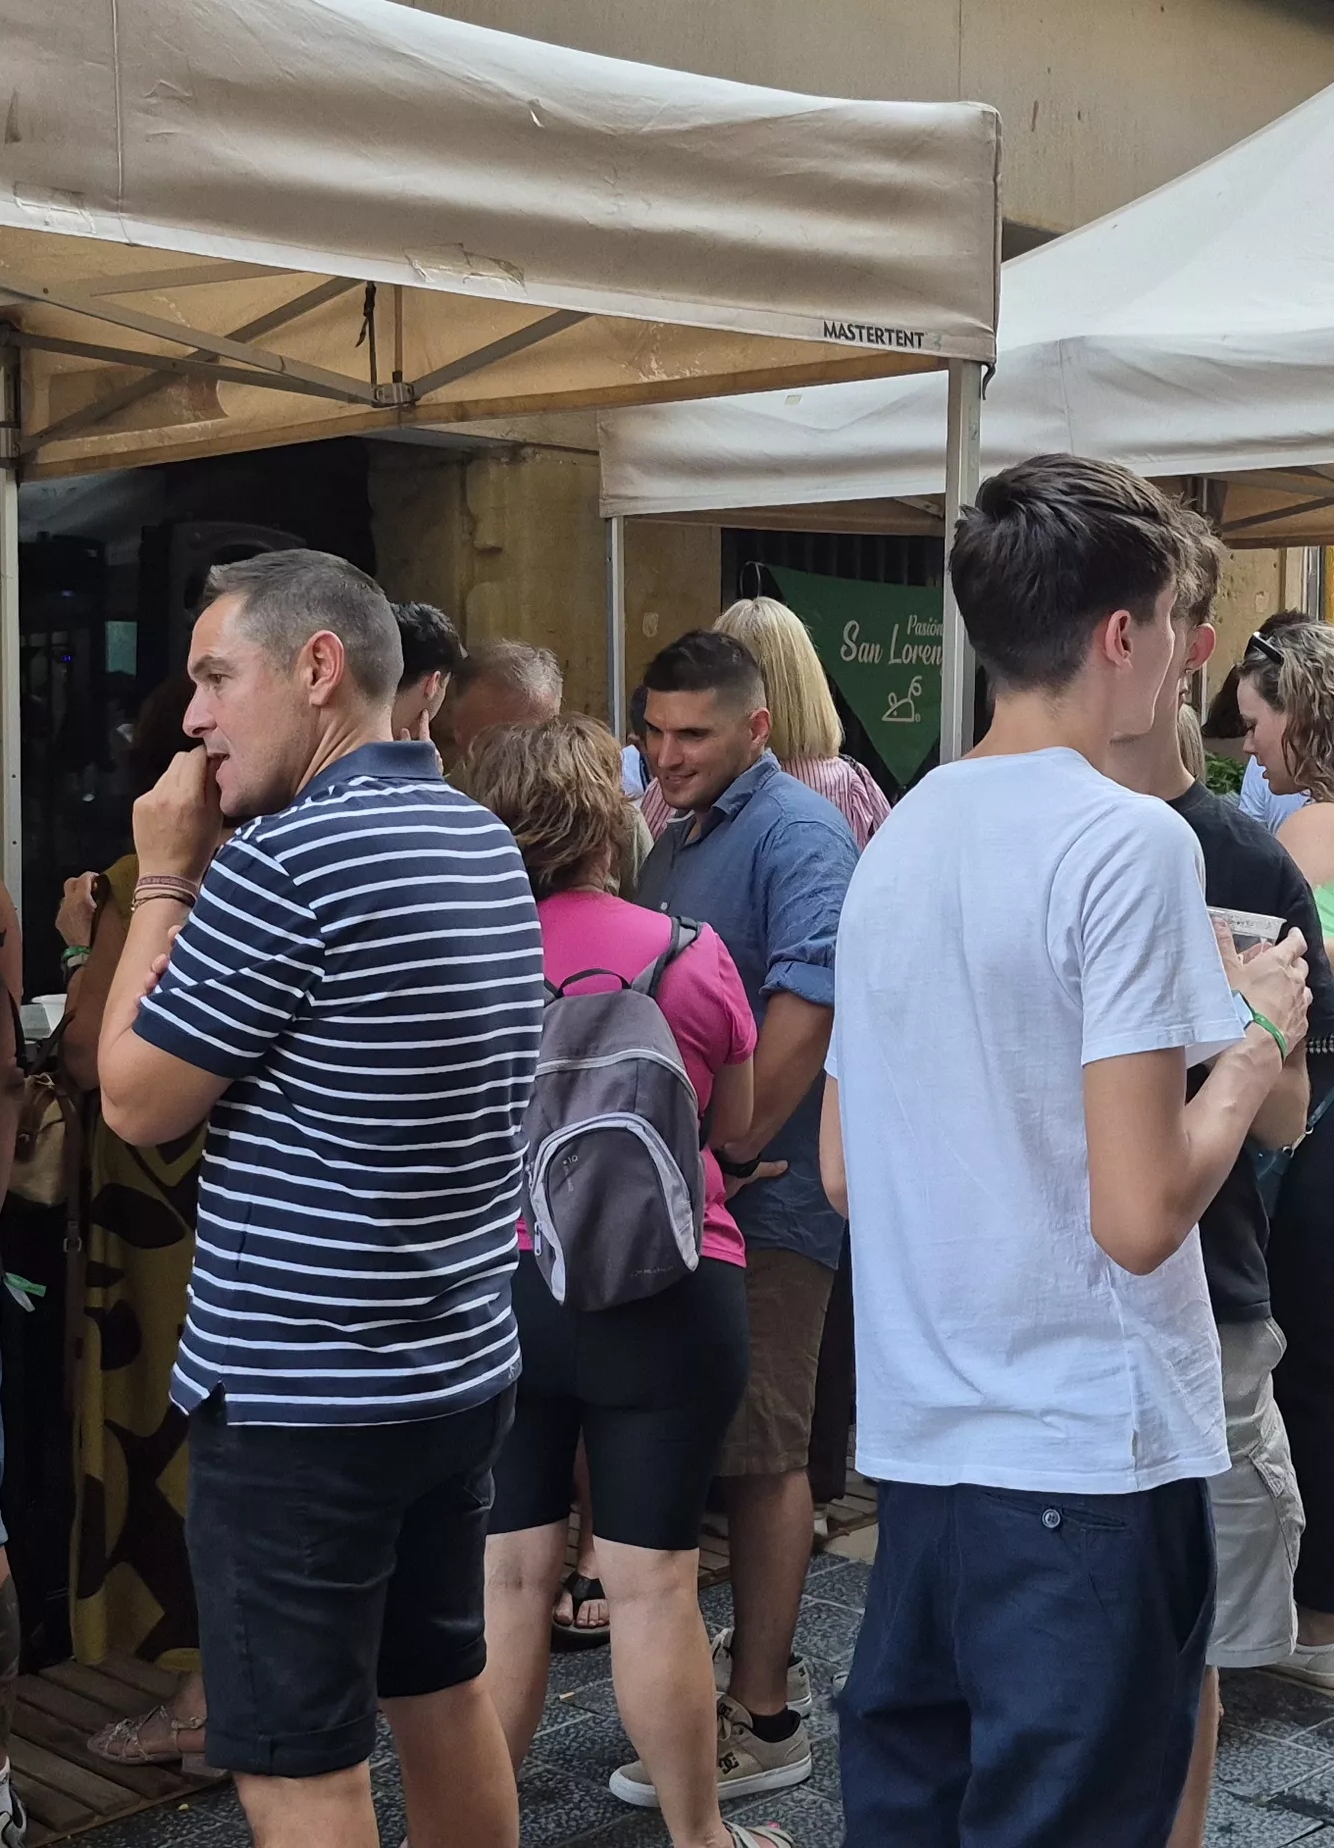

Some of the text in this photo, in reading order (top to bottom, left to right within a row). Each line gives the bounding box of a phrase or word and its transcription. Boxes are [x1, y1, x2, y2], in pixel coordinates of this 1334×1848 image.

[823, 321, 925, 350] MASTERTENT
[840, 619, 945, 672] San Loren
